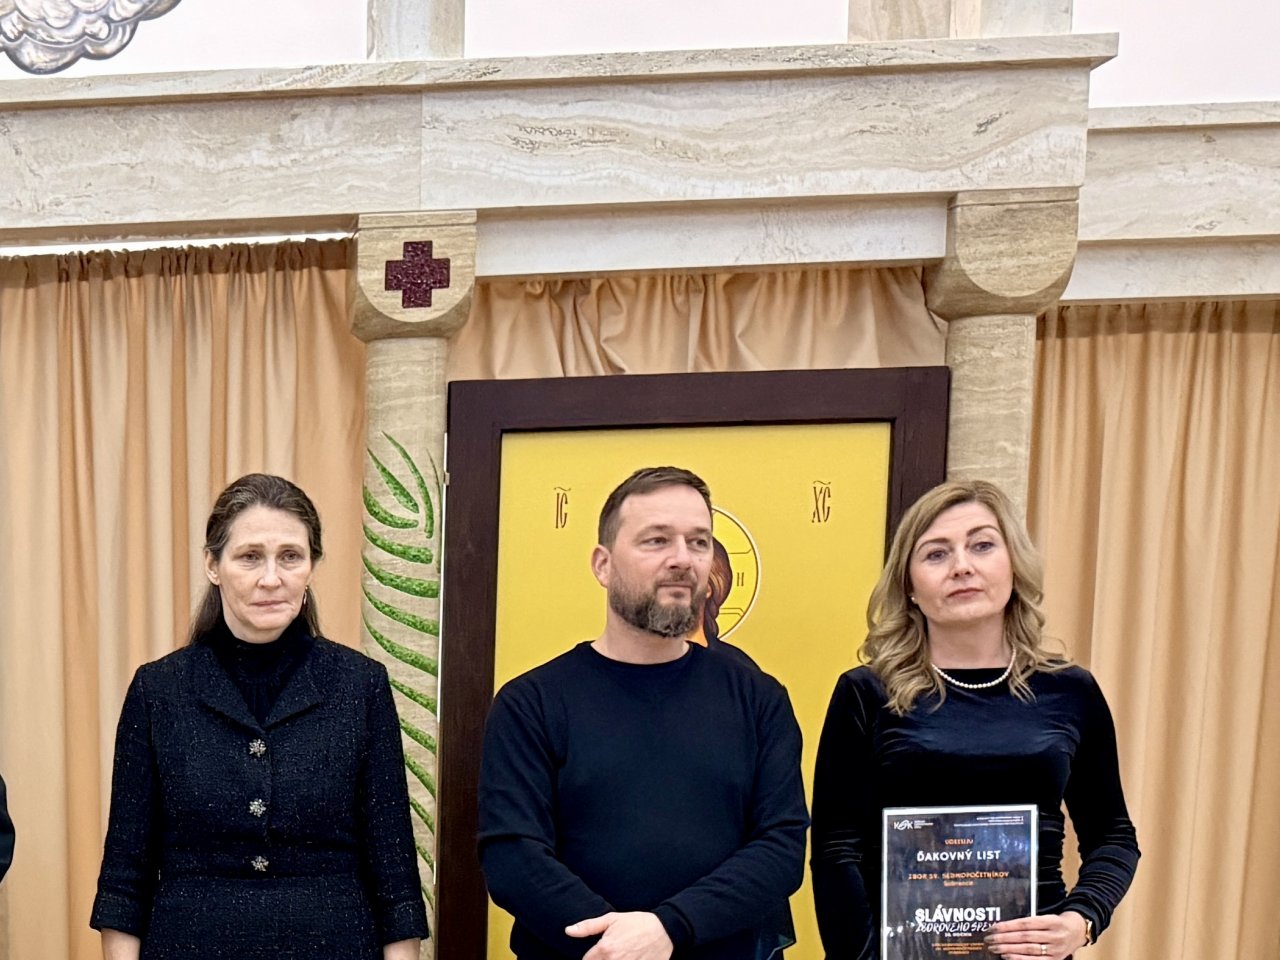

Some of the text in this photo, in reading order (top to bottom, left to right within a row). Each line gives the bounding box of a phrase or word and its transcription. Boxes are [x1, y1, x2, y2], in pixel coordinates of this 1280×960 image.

[917, 848, 1002, 862] ĎAKOVNÝ LIST
[915, 904, 1001, 923] SLÁVNOSTI
